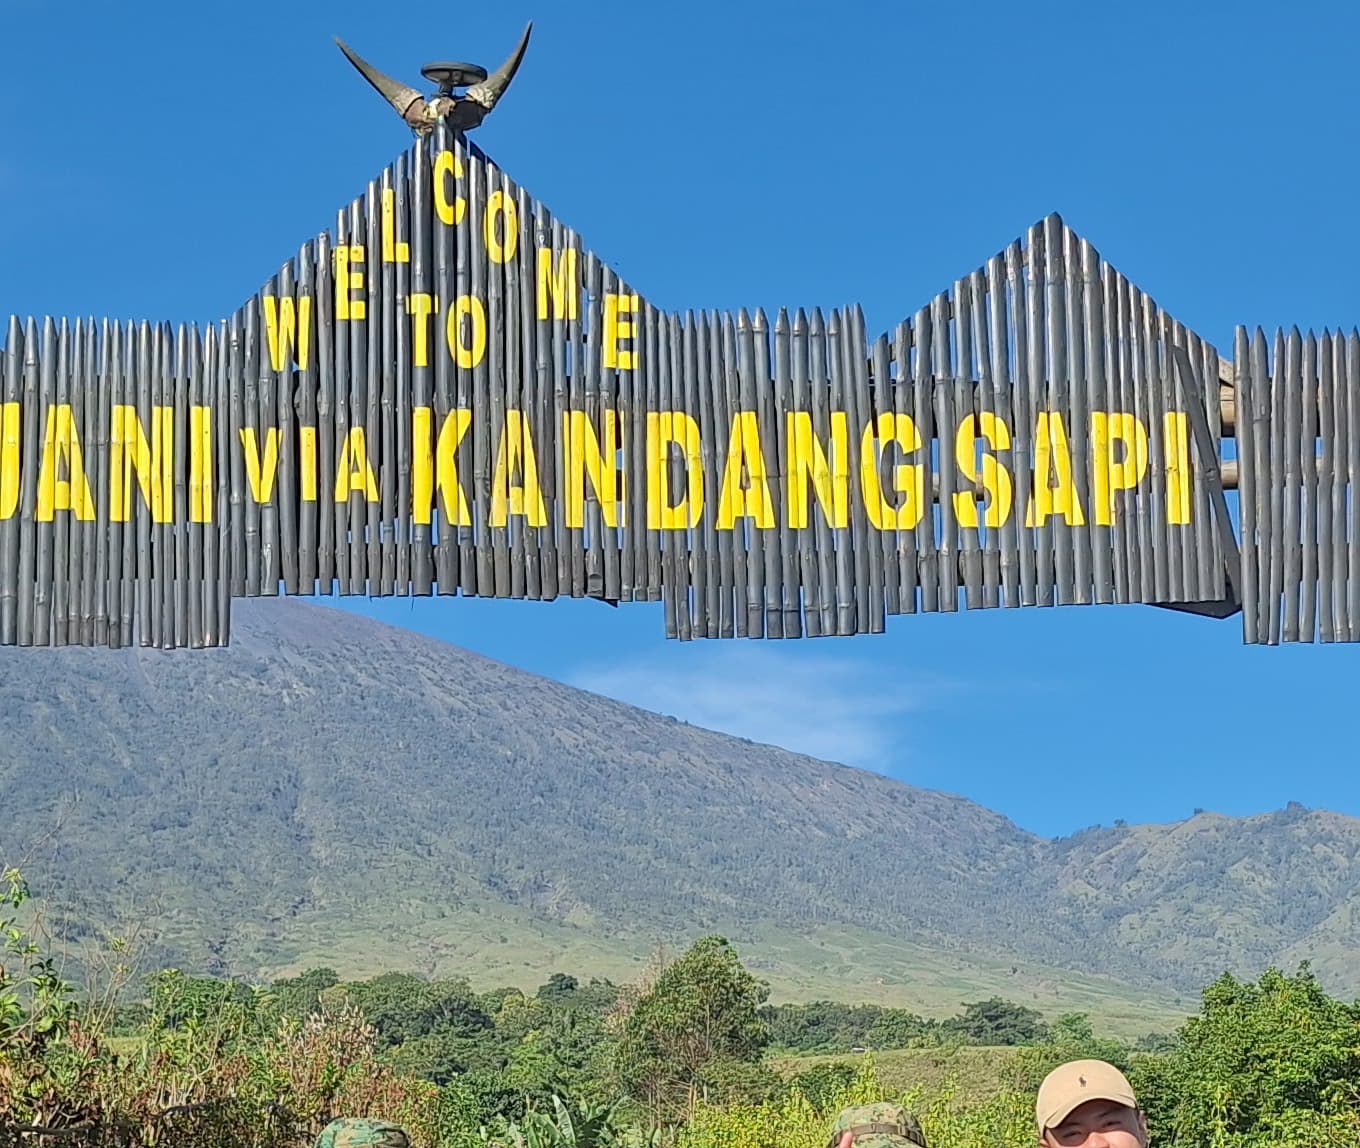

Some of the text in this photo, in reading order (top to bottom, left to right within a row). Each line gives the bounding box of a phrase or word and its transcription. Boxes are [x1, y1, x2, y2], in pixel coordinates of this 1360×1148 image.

[263, 150, 640, 372] WELCOME
[406, 293, 487, 369] TO
[240, 427, 378, 503] VIA
